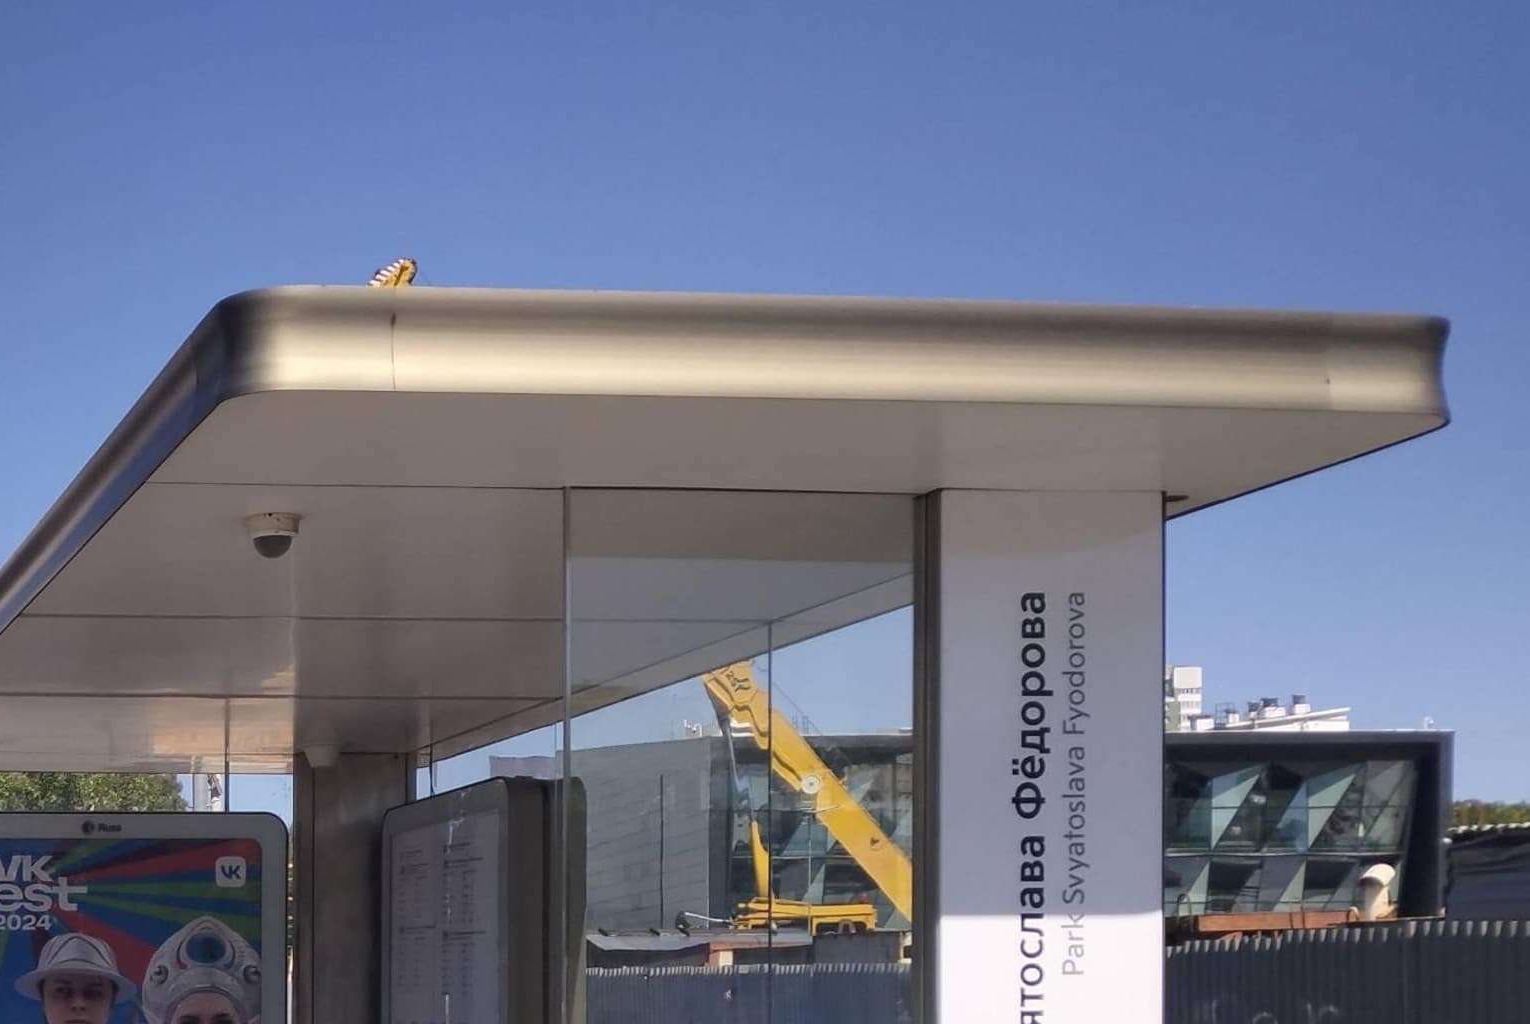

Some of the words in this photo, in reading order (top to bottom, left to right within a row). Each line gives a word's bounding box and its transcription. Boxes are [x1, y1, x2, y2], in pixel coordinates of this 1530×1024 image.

[1011, 591, 1054, 820] Фёдорова
[1062, 591, 1091, 735] Fyodorova
[220, 865, 244, 880] VK
[1062, 745, 1091, 905] Svyatoslava
[1061, 912, 1086, 976] Park
